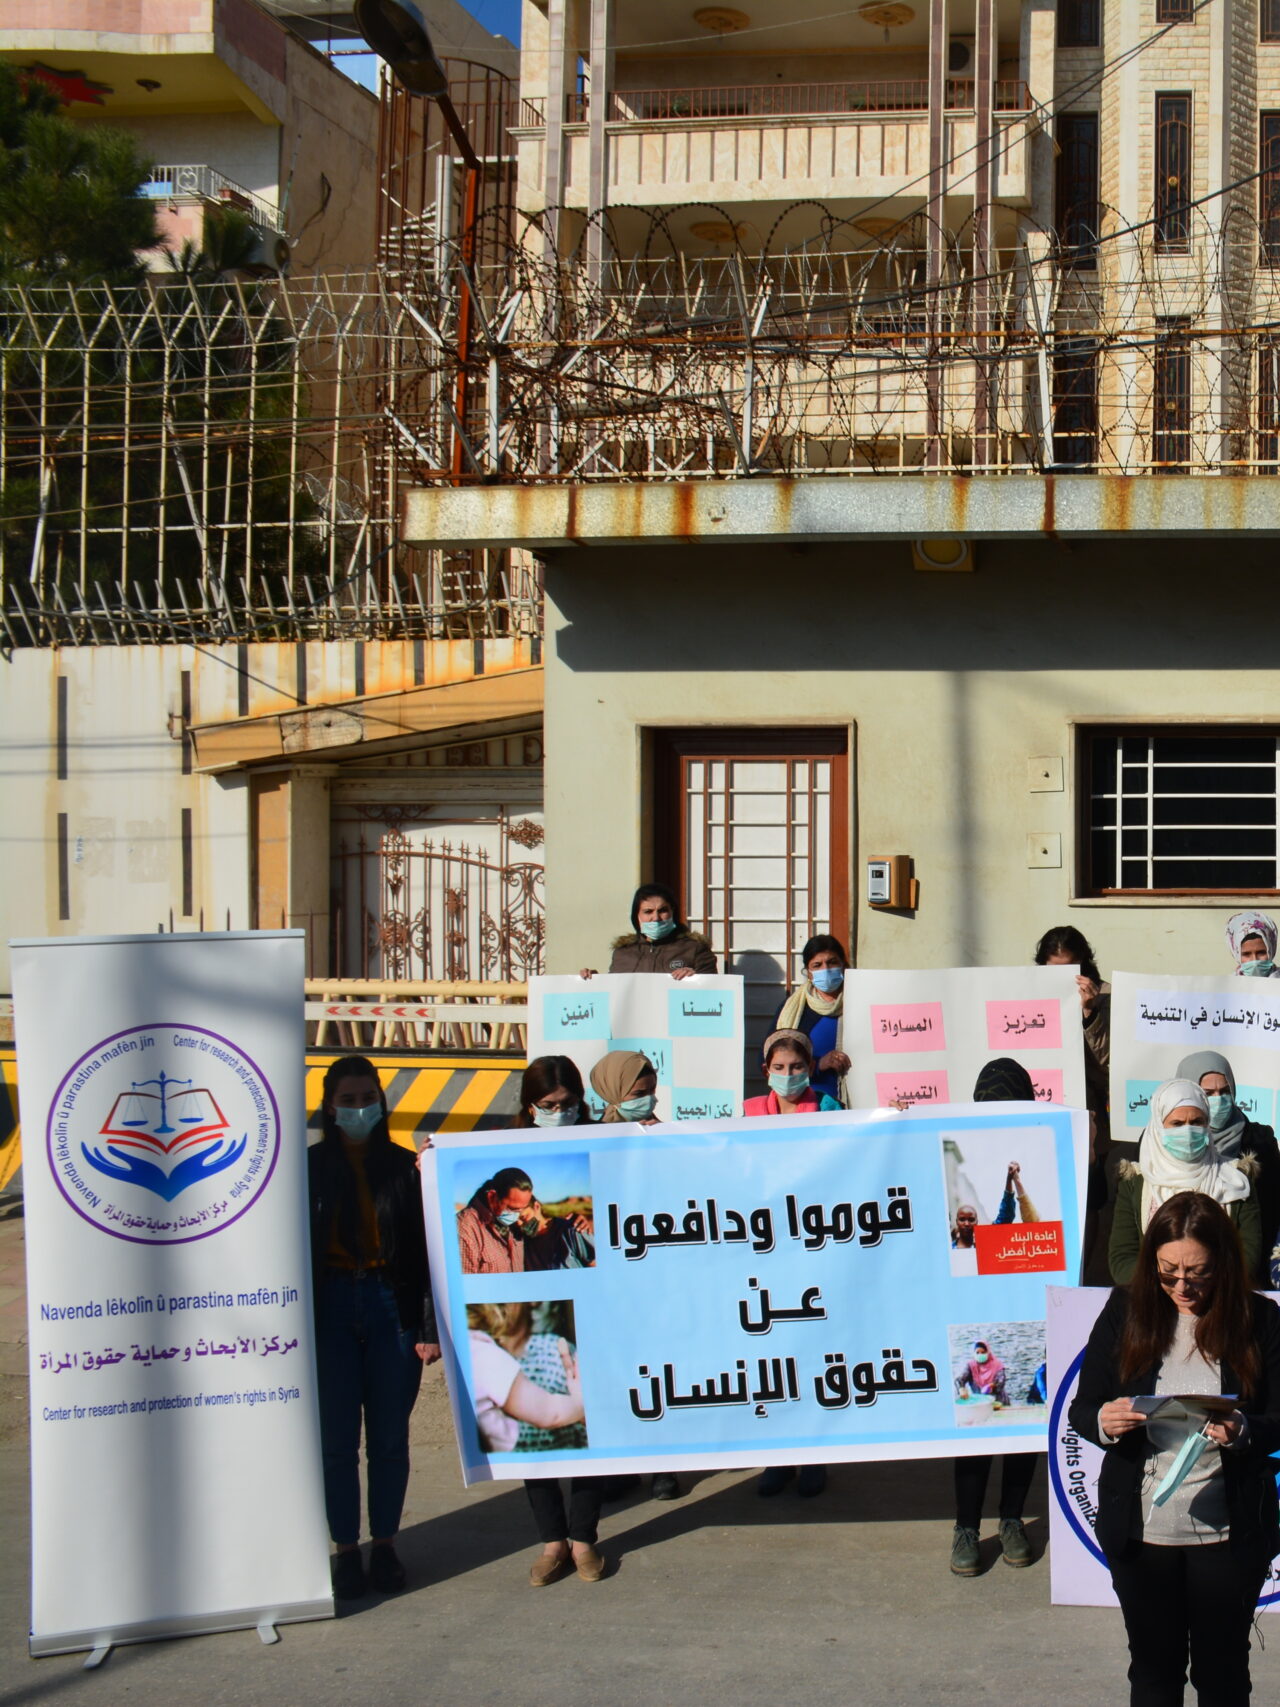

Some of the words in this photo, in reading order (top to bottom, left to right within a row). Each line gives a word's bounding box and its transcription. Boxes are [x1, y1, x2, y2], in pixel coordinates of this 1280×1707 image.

[560, 1003, 594, 1026] آمنين
[682, 1001, 723, 1017] لسنا
[1140, 1004, 1187, 1025] التنمية
[1190, 1006, 1208, 1030] في
[1212, 1009, 1260, 1029] الإنسان
[880, 1017, 932, 1037] المساواة
[1003, 1013, 1046, 1034] تعزيز
[100, 1040, 138, 1063] mafên
[139, 1036, 155, 1051] jin
[173, 1034, 198, 1049] Center
[198, 1038, 209, 1051] for
[210, 1046, 239, 1070] research
[235, 1065, 249, 1080] and
[62, 1060, 101, 1110] parastina
[242, 1077, 267, 1112] protection
[258, 1113, 271, 1121] of
[676, 1103, 711, 1120] الجميع
[256, 1121, 268, 1155] women's
[248, 1154, 263, 1175] rights
[64, 1161, 102, 1208] Navenda
[244, 1173, 255, 1182] in
[229, 1180, 250, 1199] Syria
[103, 1204, 124, 1221] المرأة
[208, 1200, 228, 1218] مركز
[784, 1186, 914, 1250] قوموا
[122, 1214, 147, 1228] حقوق
[607, 1198, 775, 1261] ودافعوا
[1010, 1231, 1033, 1242] البناء
[1034, 1230, 1057, 1243] إعادة
[1027, 1244, 1058, 1258] بشكل
[41, 1301, 103, 1321] Navenda
[106, 1296, 154, 1316] lêkolîn
[157, 1294, 166, 1312] û
[169, 1290, 234, 1314] parastina
[237, 1288, 279, 1307] mafên
[281, 1286, 298, 1308] jin
[738, 1277, 827, 1336] عن
[195, 1336, 256, 1359] الأبحاث
[261, 1335, 298, 1356] مركز
[40, 1352, 78, 1373] المرأة
[82, 1349, 126, 1371] حقوق
[628, 1356, 800, 1421] الإنسان
[813, 1347, 939, 1409] حقوق
[43, 1406, 71, 1421] Center
[73, 1404, 87, 1419] for
[88, 1401, 128, 1418] research
[130, 1398, 147, 1413] and
[149, 1395, 192, 1413] protection
[194, 1393, 203, 1407] of
[203, 1392, 241, 1406] women's
[242, 1389, 267, 1406] rights
[268, 1388, 277, 1401] in
[278, 1386, 300, 1404] Syria
[1061, 1423, 1083, 1467] ights
[1069, 1470, 1099, 1528] Organiza
